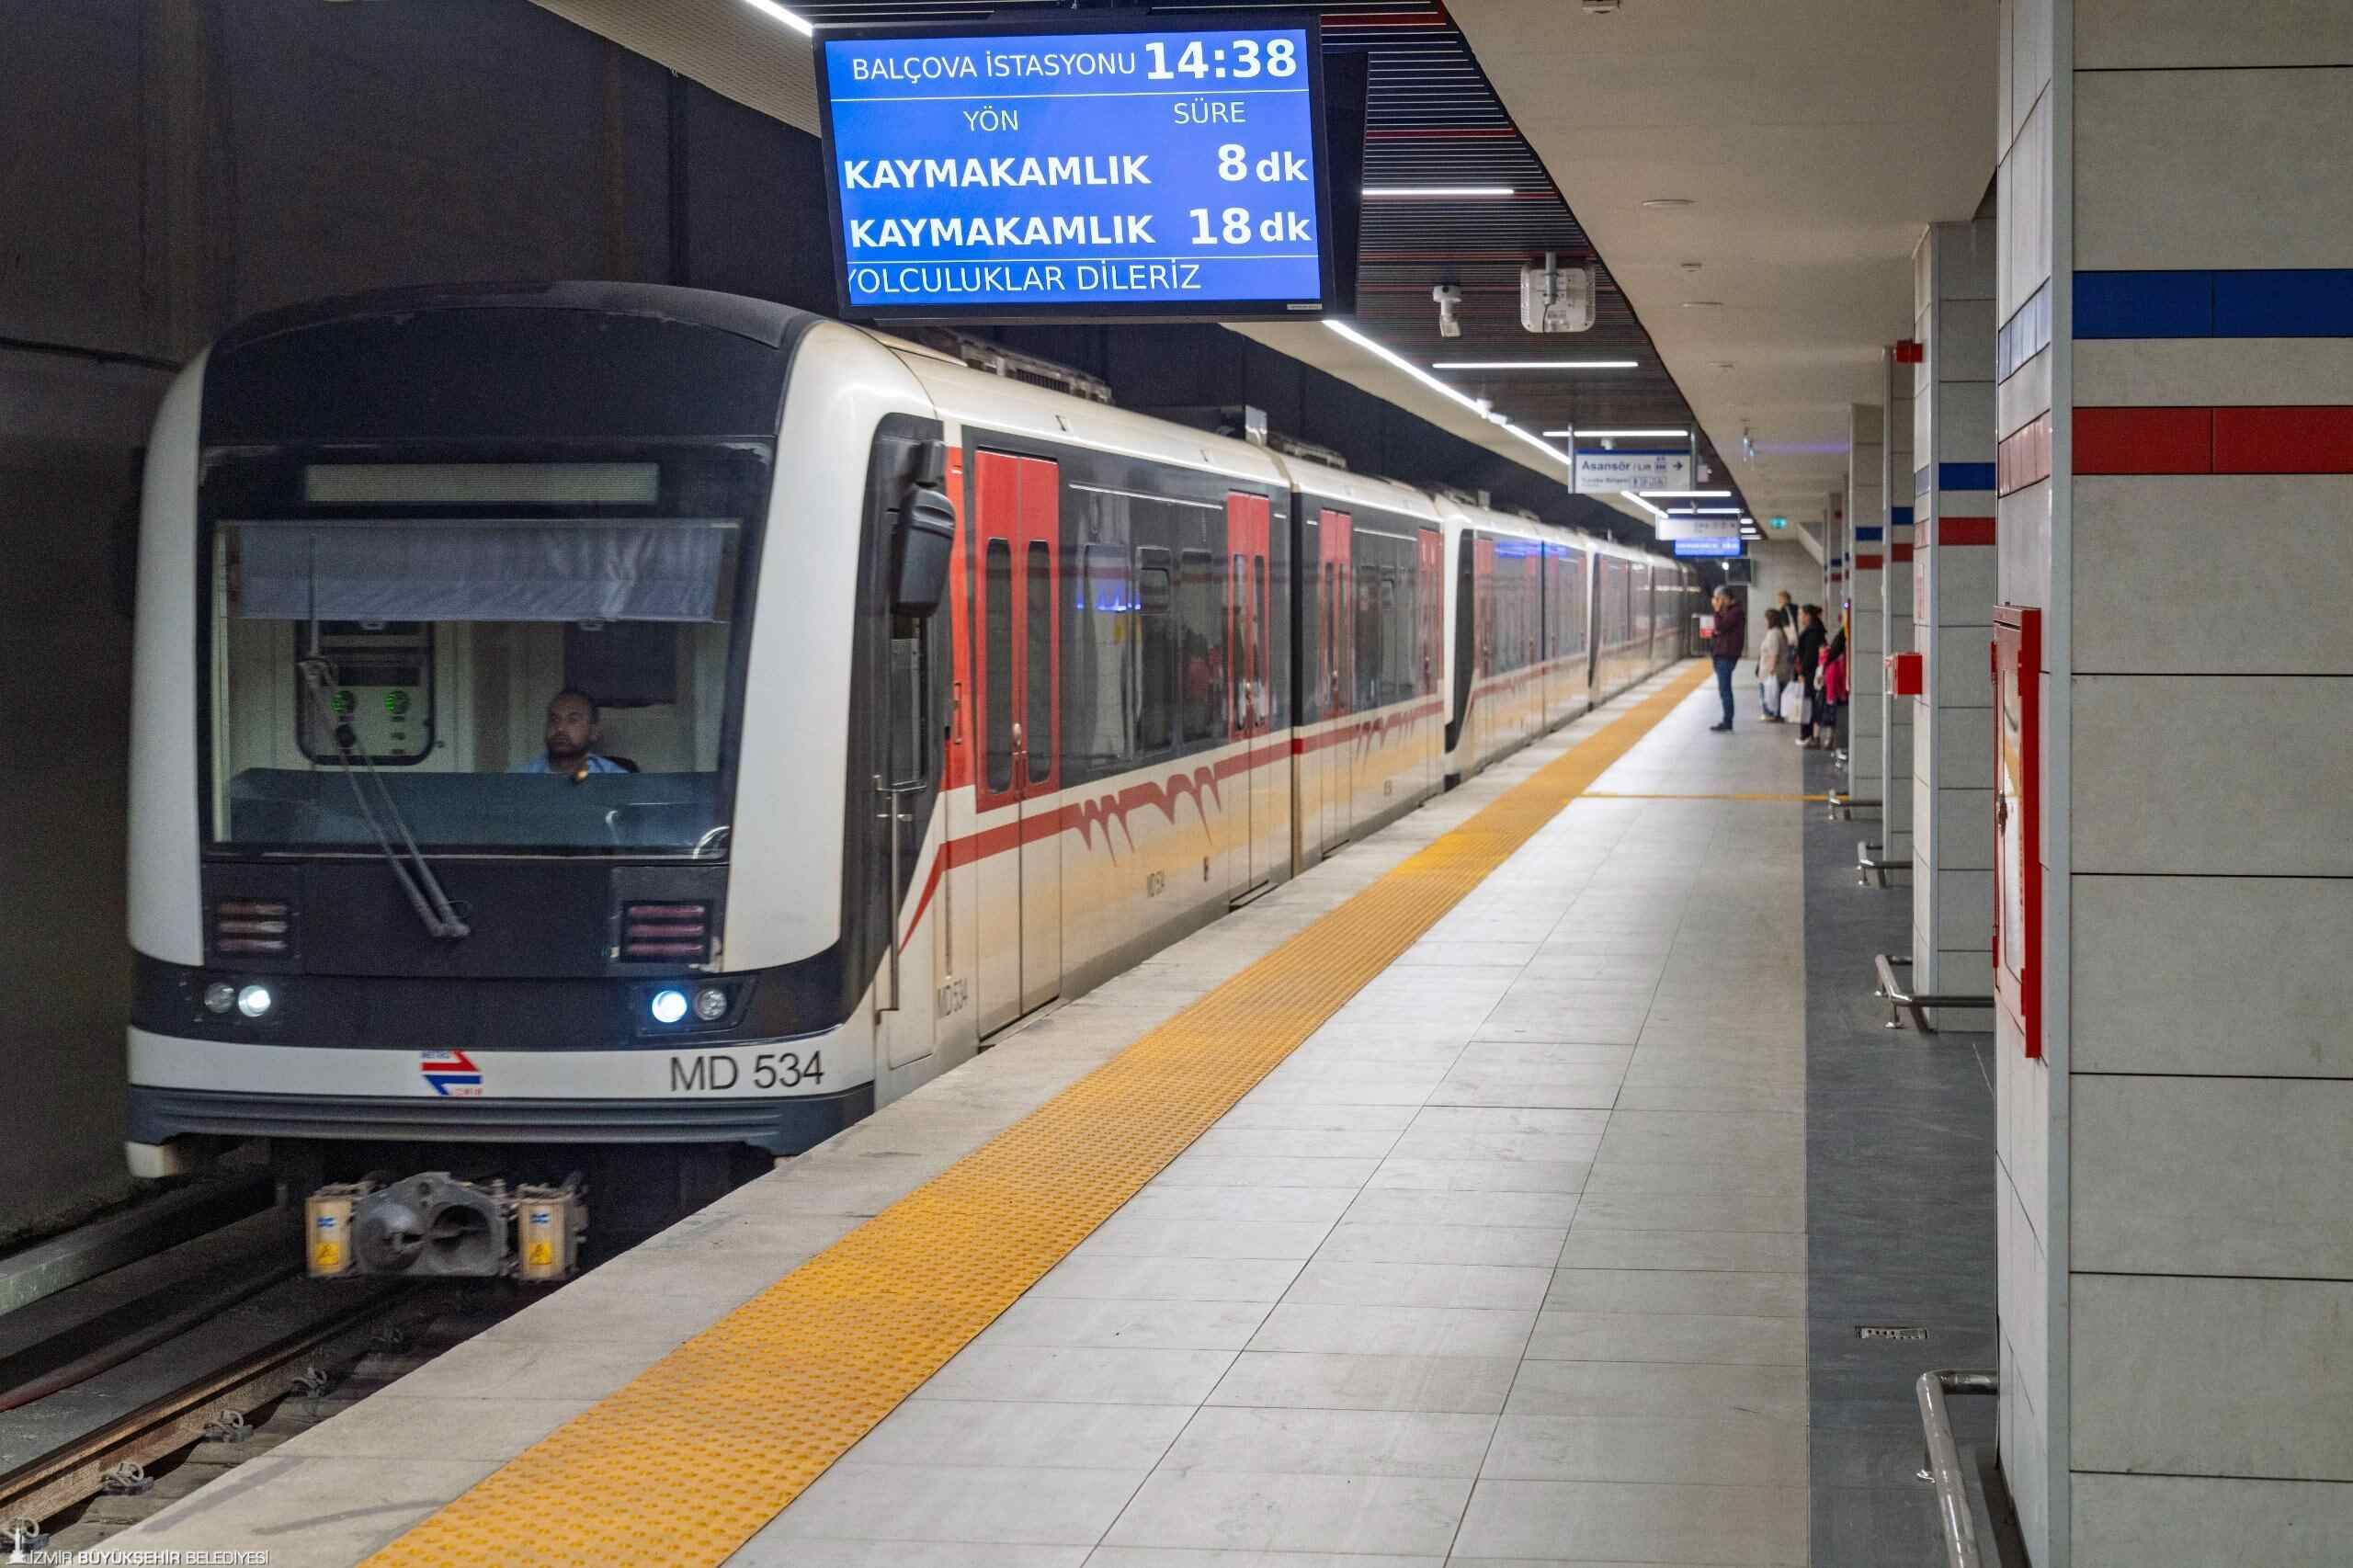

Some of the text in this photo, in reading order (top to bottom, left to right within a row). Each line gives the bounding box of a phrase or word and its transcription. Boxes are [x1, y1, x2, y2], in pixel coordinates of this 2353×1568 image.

[852, 51, 1136, 84] BALÇOVA İSTASYONU
[1145, 39, 1297, 80] 14:38
[962, 105, 1018, 131] YÖN
[1174, 97, 1246, 124] SÜRE
[844, 143, 1310, 189] KAYMAKAMLIK 8 dk
[850, 207, 1313, 247] KAYMAKAMLIK 18 dk
[1077, 258, 1201, 290] DİLERİZ
[1582, 460, 1631, 472] Asansör
[670, 1051, 825, 1091] MD 534
